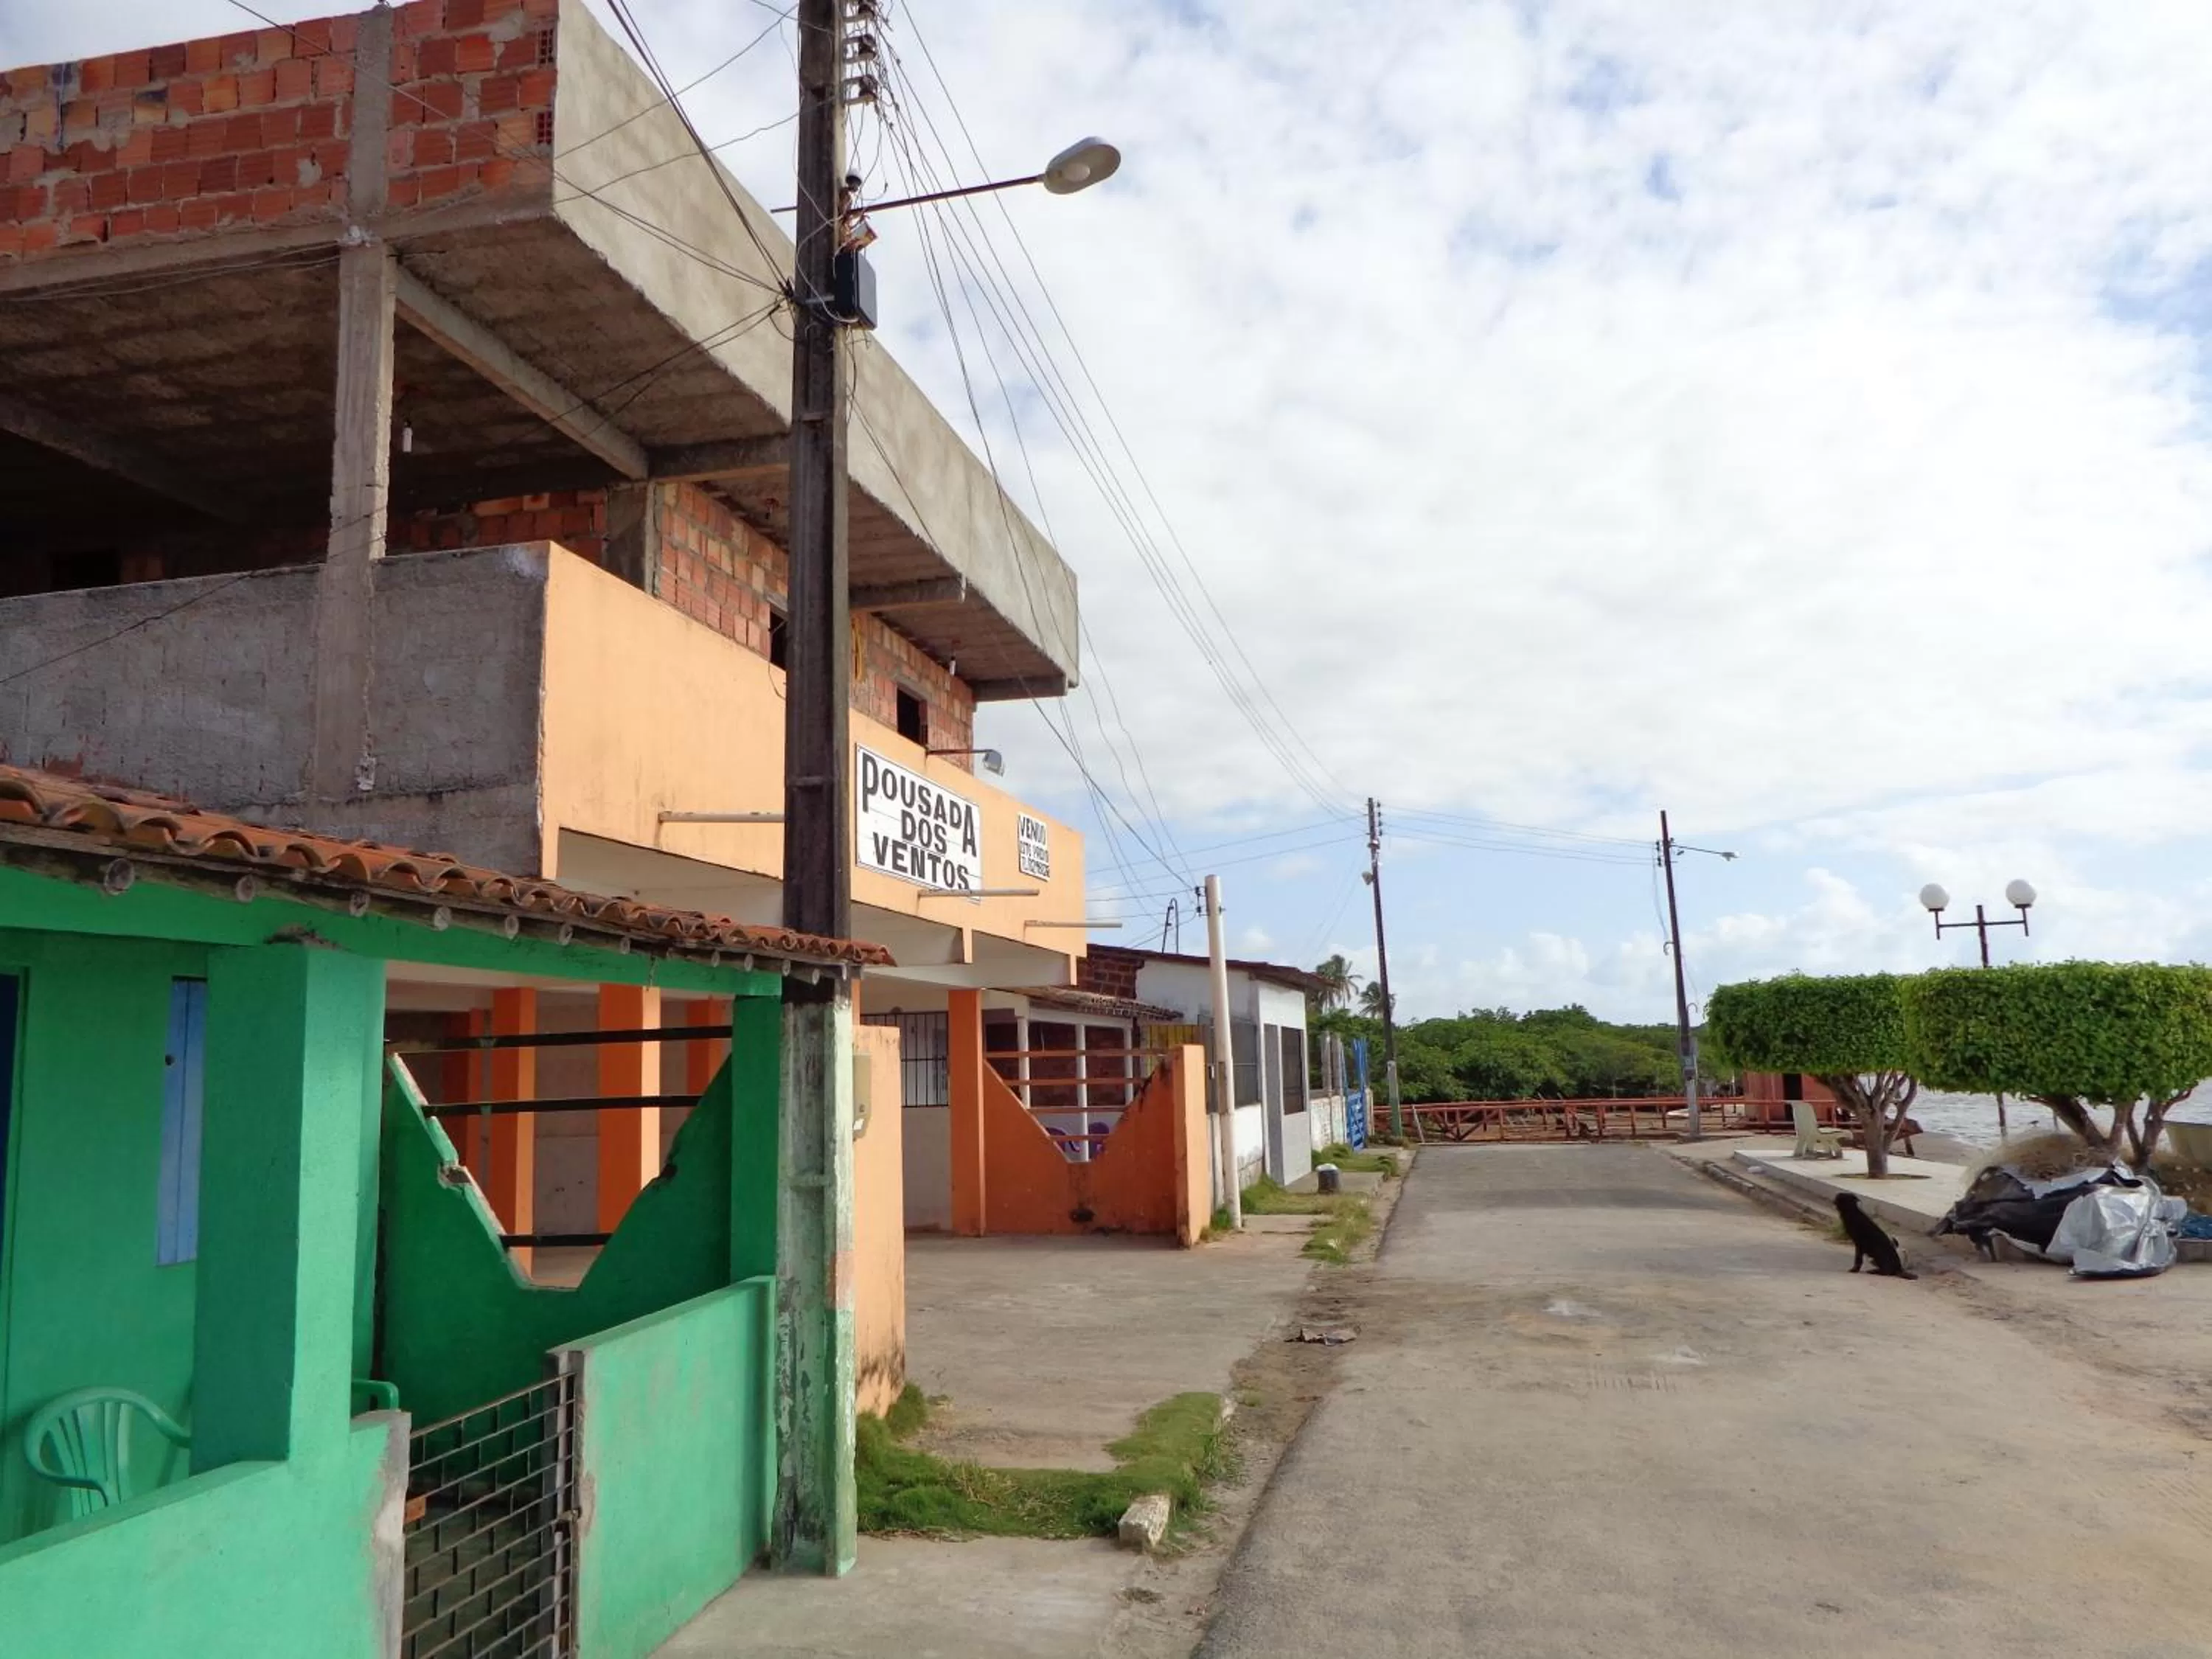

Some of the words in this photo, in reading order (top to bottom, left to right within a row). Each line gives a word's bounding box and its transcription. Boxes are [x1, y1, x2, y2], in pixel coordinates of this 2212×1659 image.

[862, 751, 977, 858] POUSADA
[1020, 815, 1046, 846] VENDO
[900, 809, 947, 855] DOS
[872, 832, 971, 891] VENTOS
